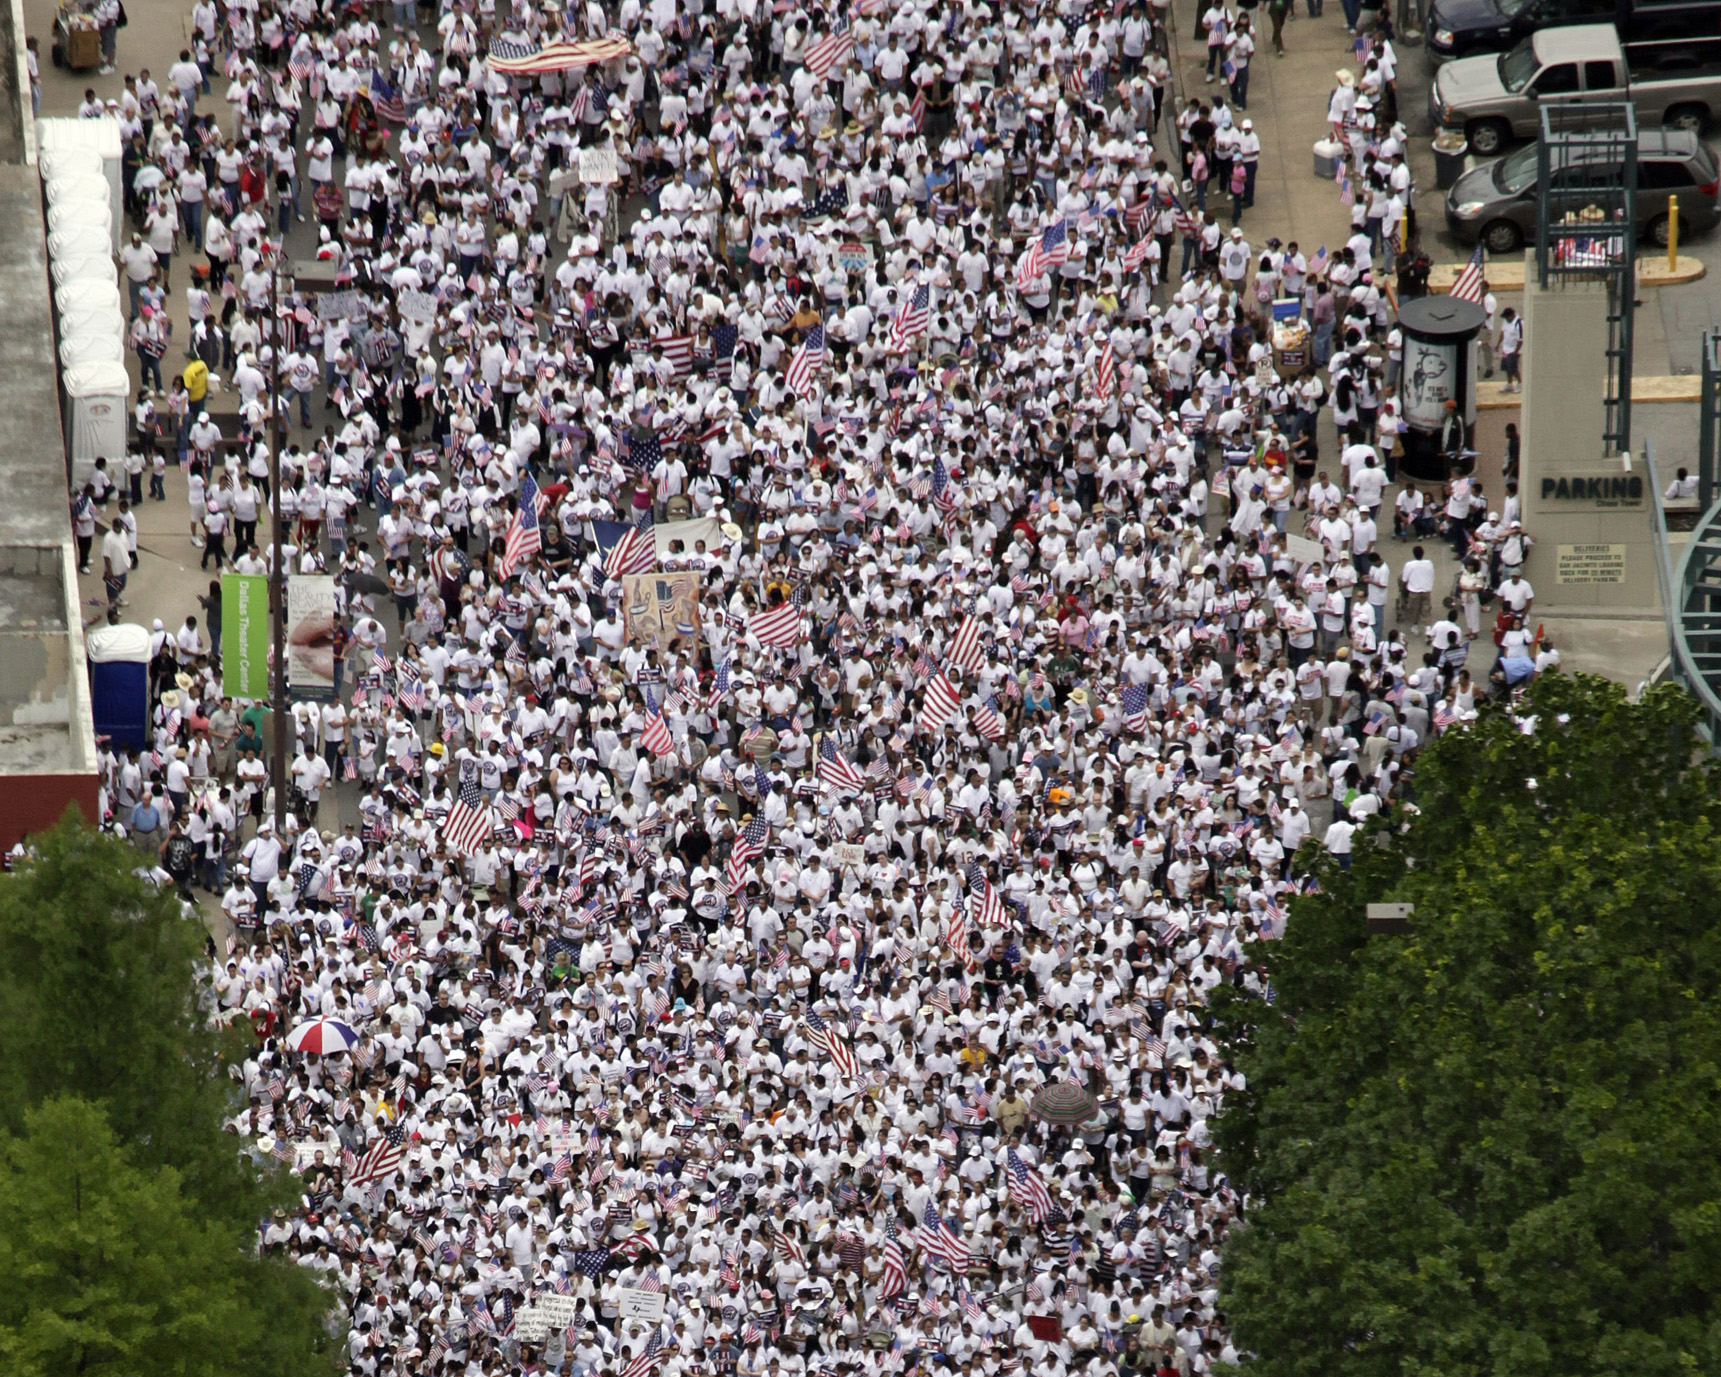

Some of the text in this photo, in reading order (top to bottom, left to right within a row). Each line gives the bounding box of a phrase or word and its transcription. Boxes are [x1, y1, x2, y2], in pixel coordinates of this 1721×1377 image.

[1541, 476, 1643, 499] PARKING
[290, 592, 333, 601] BEAUTY
[239, 581, 250, 694] Dallas Theater Center
[961, 851, 973, 864] 12
[256, 1022, 267, 1032] 44
